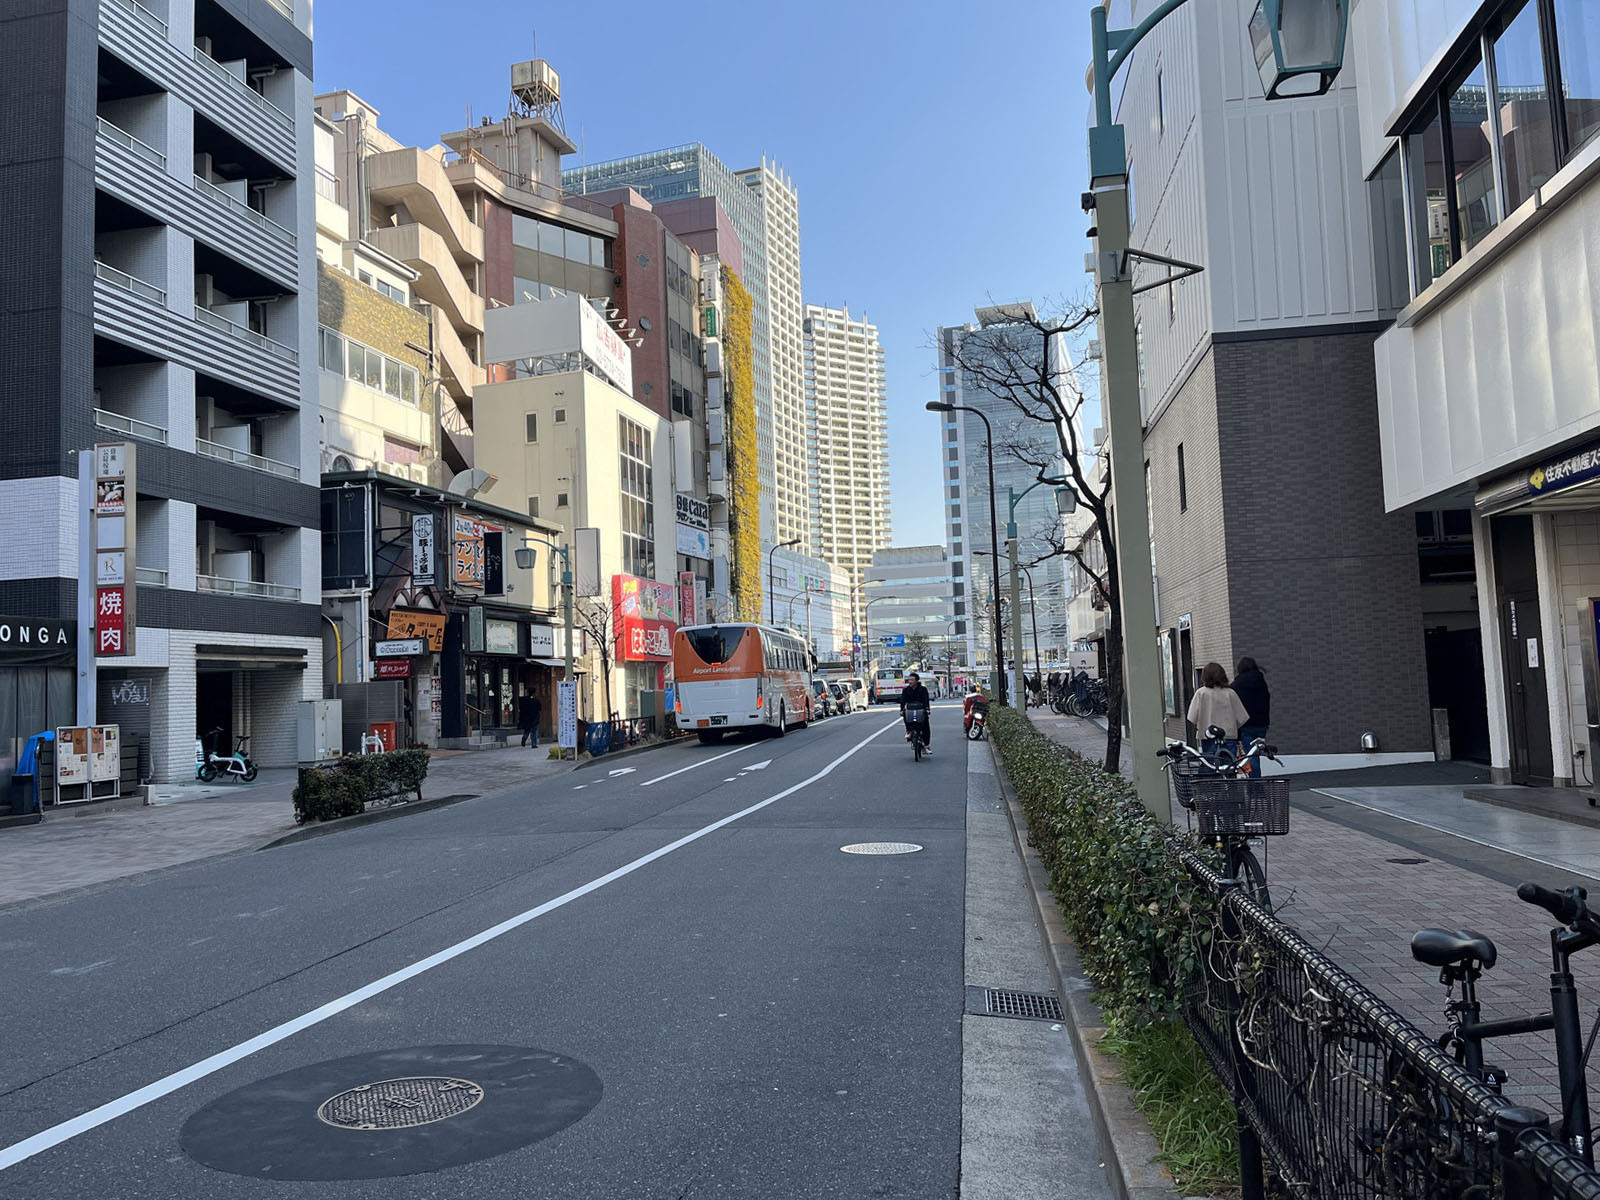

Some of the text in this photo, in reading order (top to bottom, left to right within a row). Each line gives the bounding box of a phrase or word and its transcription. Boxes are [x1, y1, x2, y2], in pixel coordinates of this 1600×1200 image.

[1545, 448, 1600, 483] 住友不動産ス
